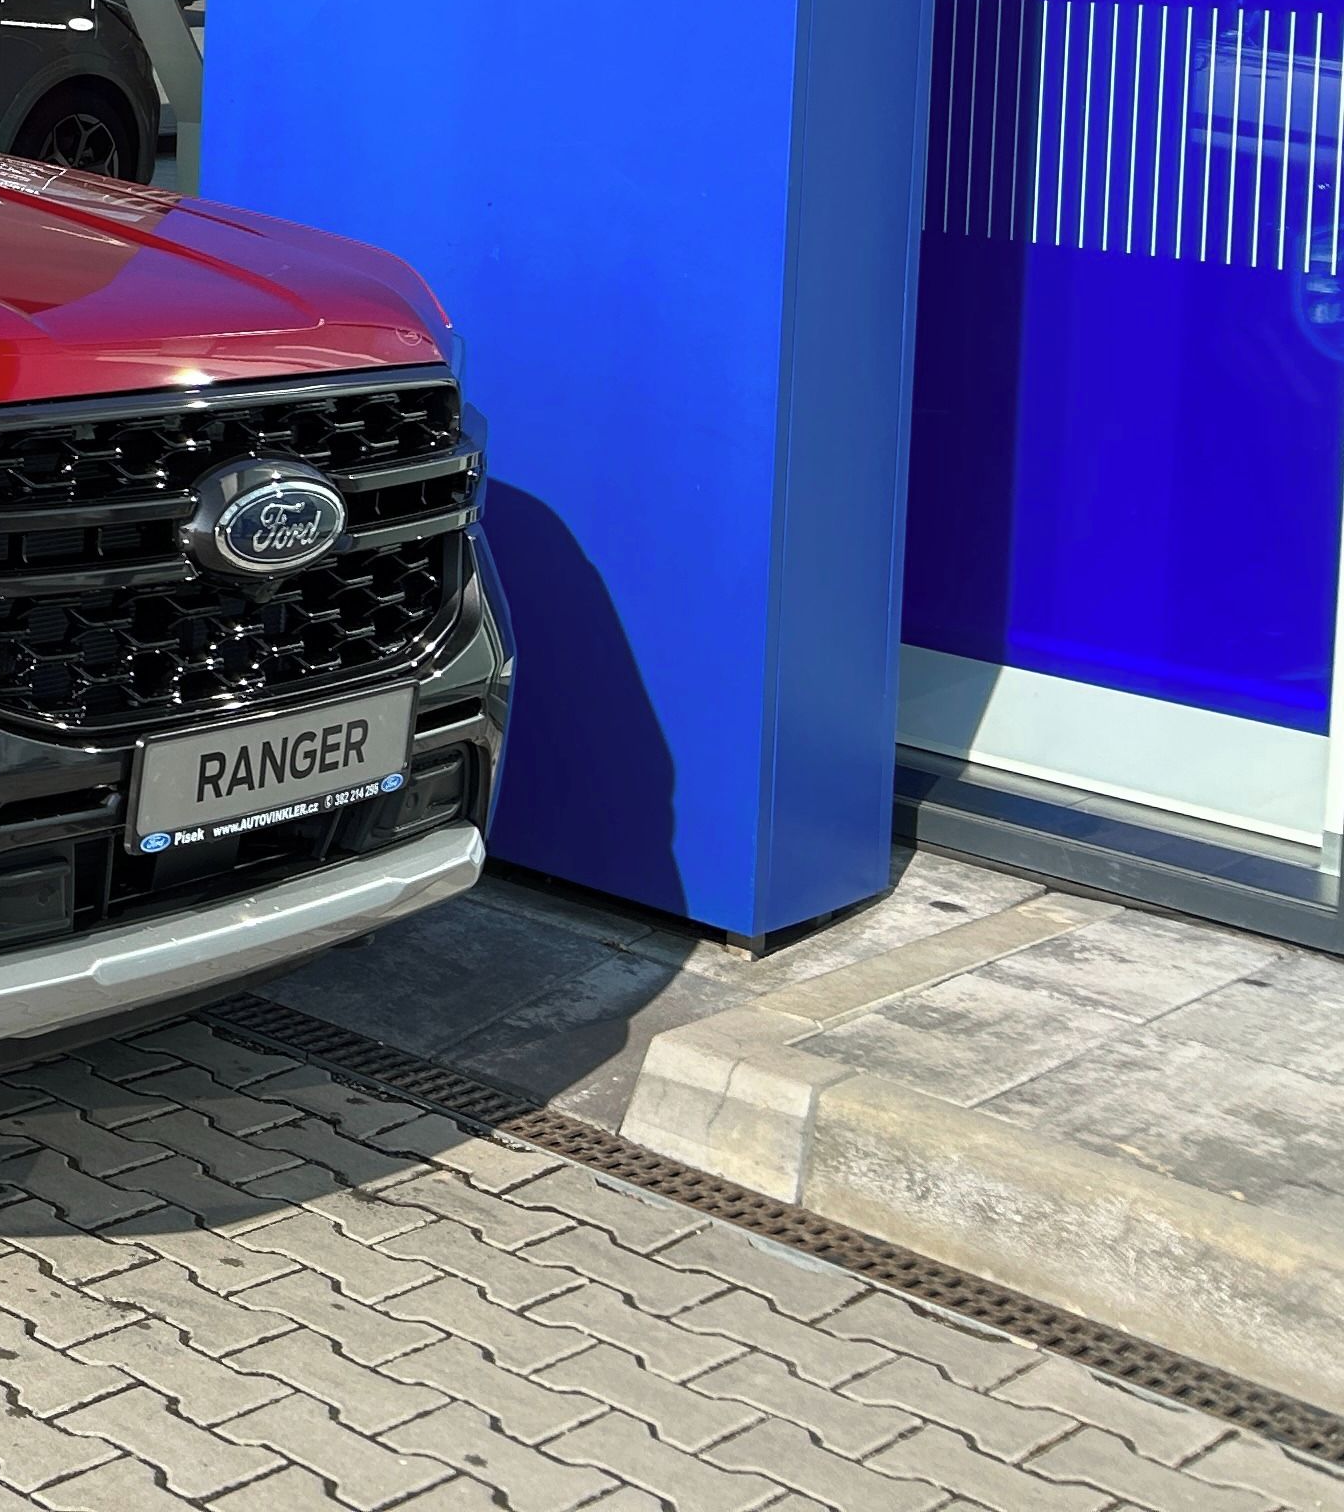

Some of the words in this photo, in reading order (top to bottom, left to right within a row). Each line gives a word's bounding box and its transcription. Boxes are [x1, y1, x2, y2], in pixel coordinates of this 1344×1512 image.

[252, 499, 322, 554] Ford
[196, 718, 369, 803] RANGER
[213, 803, 320, 837] www.AUTOVINKLER.cz
